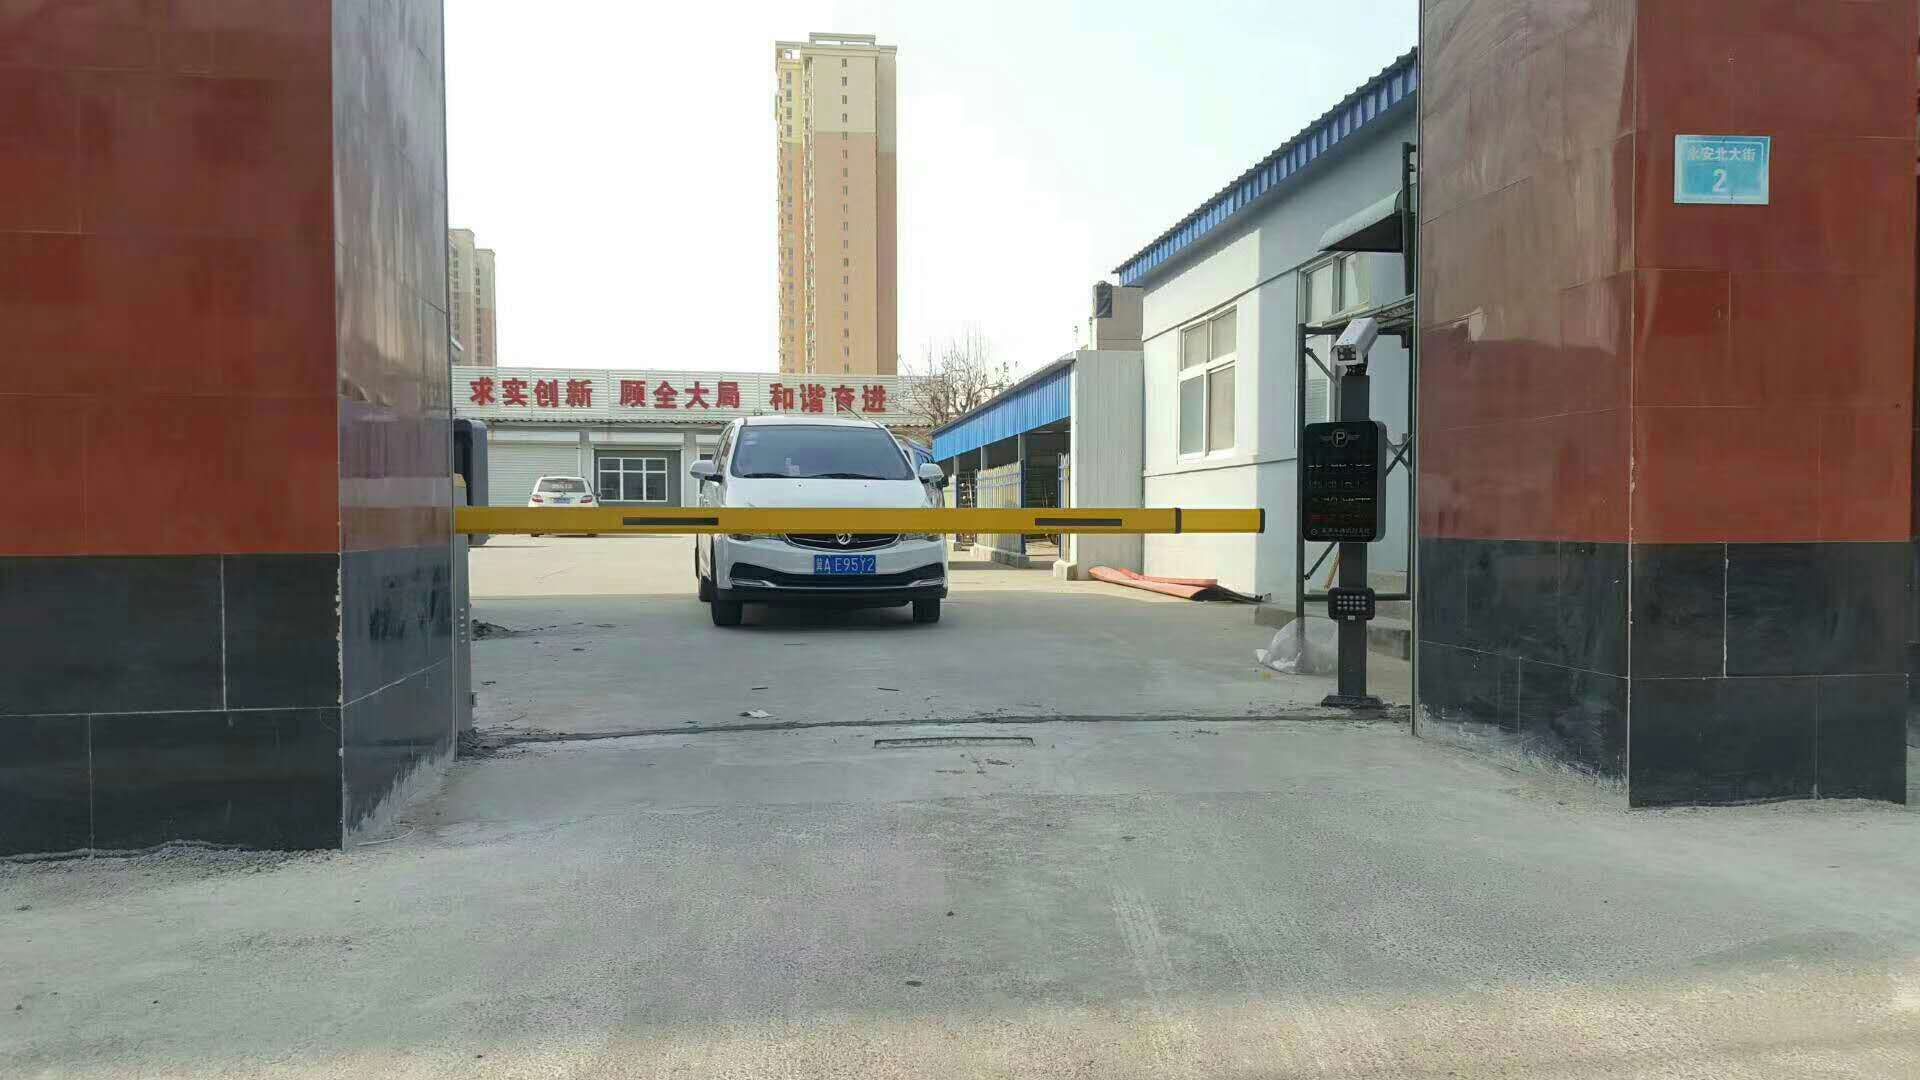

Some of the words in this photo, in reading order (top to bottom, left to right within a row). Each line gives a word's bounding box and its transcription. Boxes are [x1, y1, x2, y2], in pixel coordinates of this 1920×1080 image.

[1713, 168, 1728, 192] 2
[469, 376, 593, 408] 求实创新
[620, 379, 741, 409] 顾全大局
[769, 382, 886, 413] 和谐奋进
